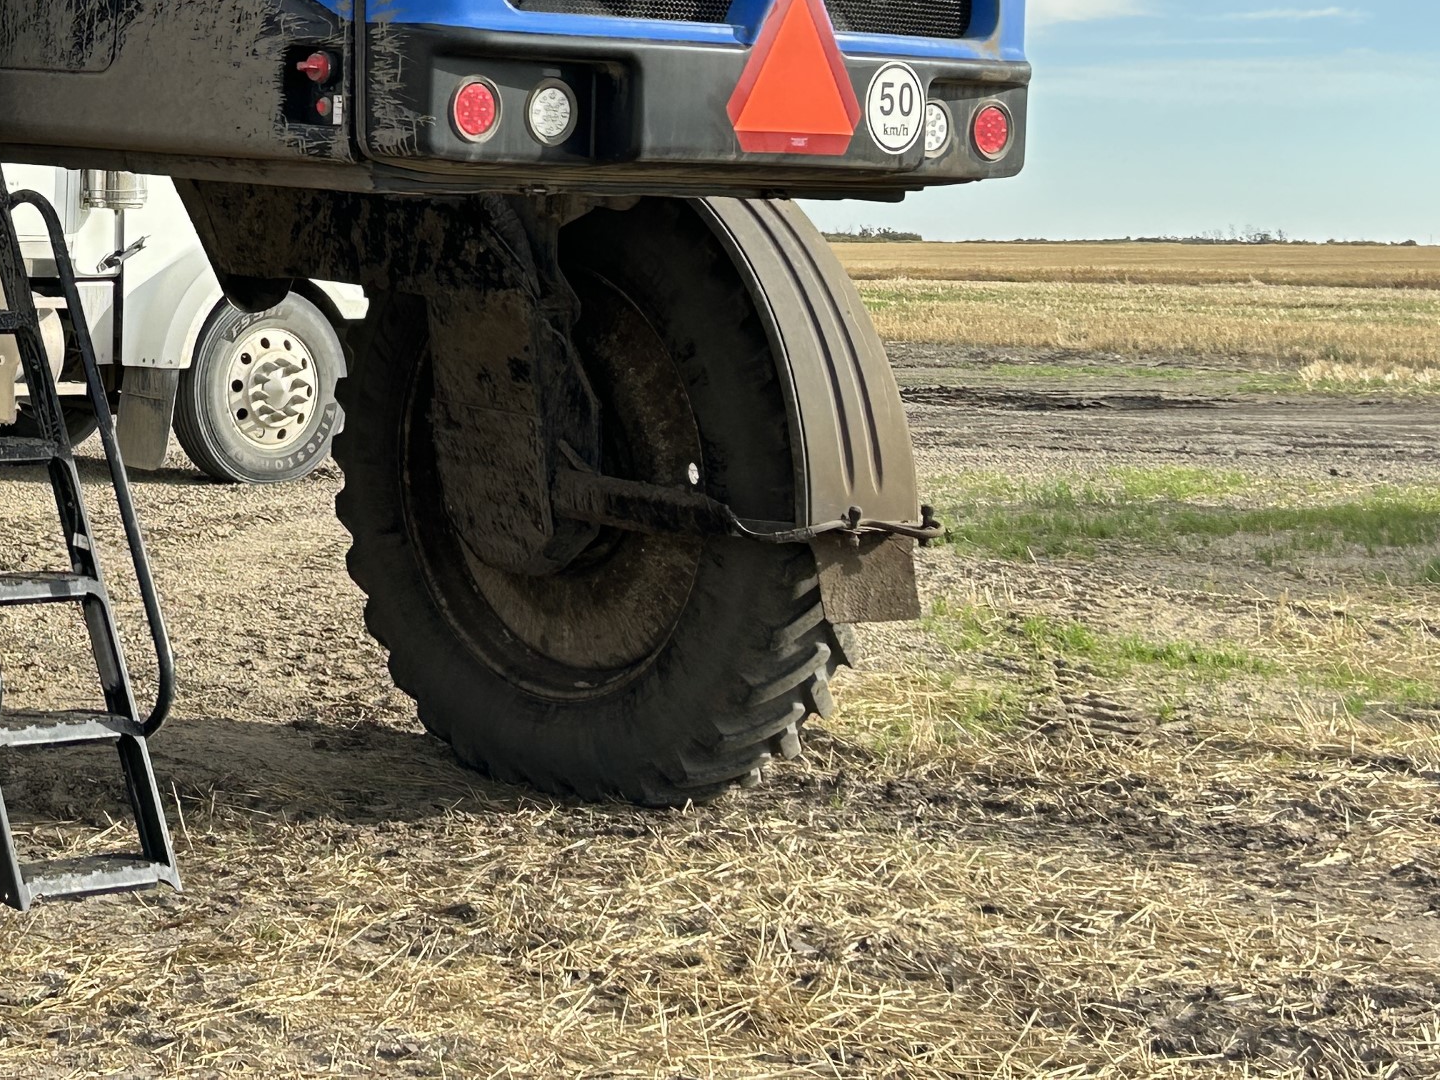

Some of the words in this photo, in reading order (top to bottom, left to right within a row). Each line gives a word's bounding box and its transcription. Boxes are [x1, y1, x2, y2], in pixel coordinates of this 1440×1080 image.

[879, 82, 914, 117] 50
[883, 123, 909, 136] km/h
[246, 402, 337, 470] Fireston
